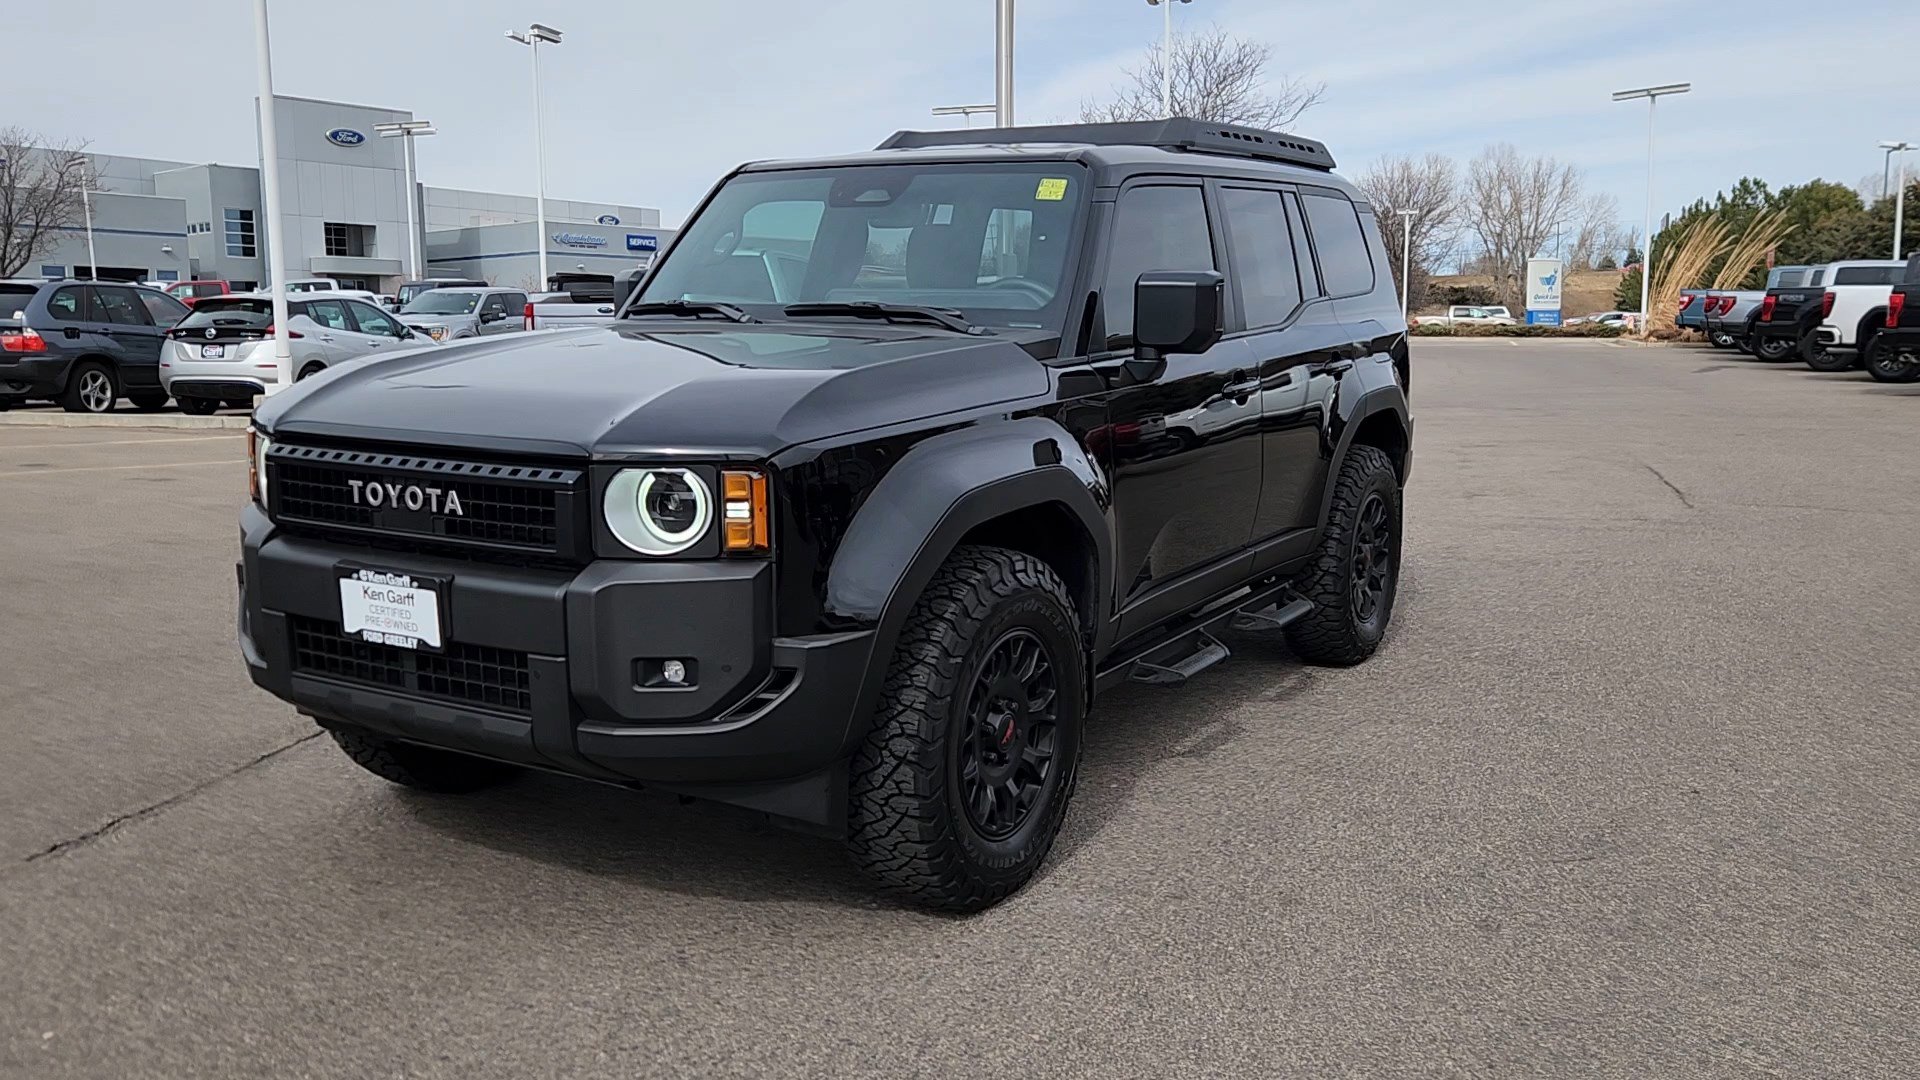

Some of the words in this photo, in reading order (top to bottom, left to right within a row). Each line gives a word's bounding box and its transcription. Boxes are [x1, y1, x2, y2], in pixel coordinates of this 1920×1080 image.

[629, 238, 656, 247] SERVICE
[348, 480, 463, 515] TOYOTA
[368, 571, 387, 584] Ken
[387, 573, 410, 588] Garff
[362, 586, 385, 602] Ken
[386, 590, 415, 607] Garff
[369, 604, 411, 620] CERTIFIED
[365, 615, 418, 632] PRE-OWNED
